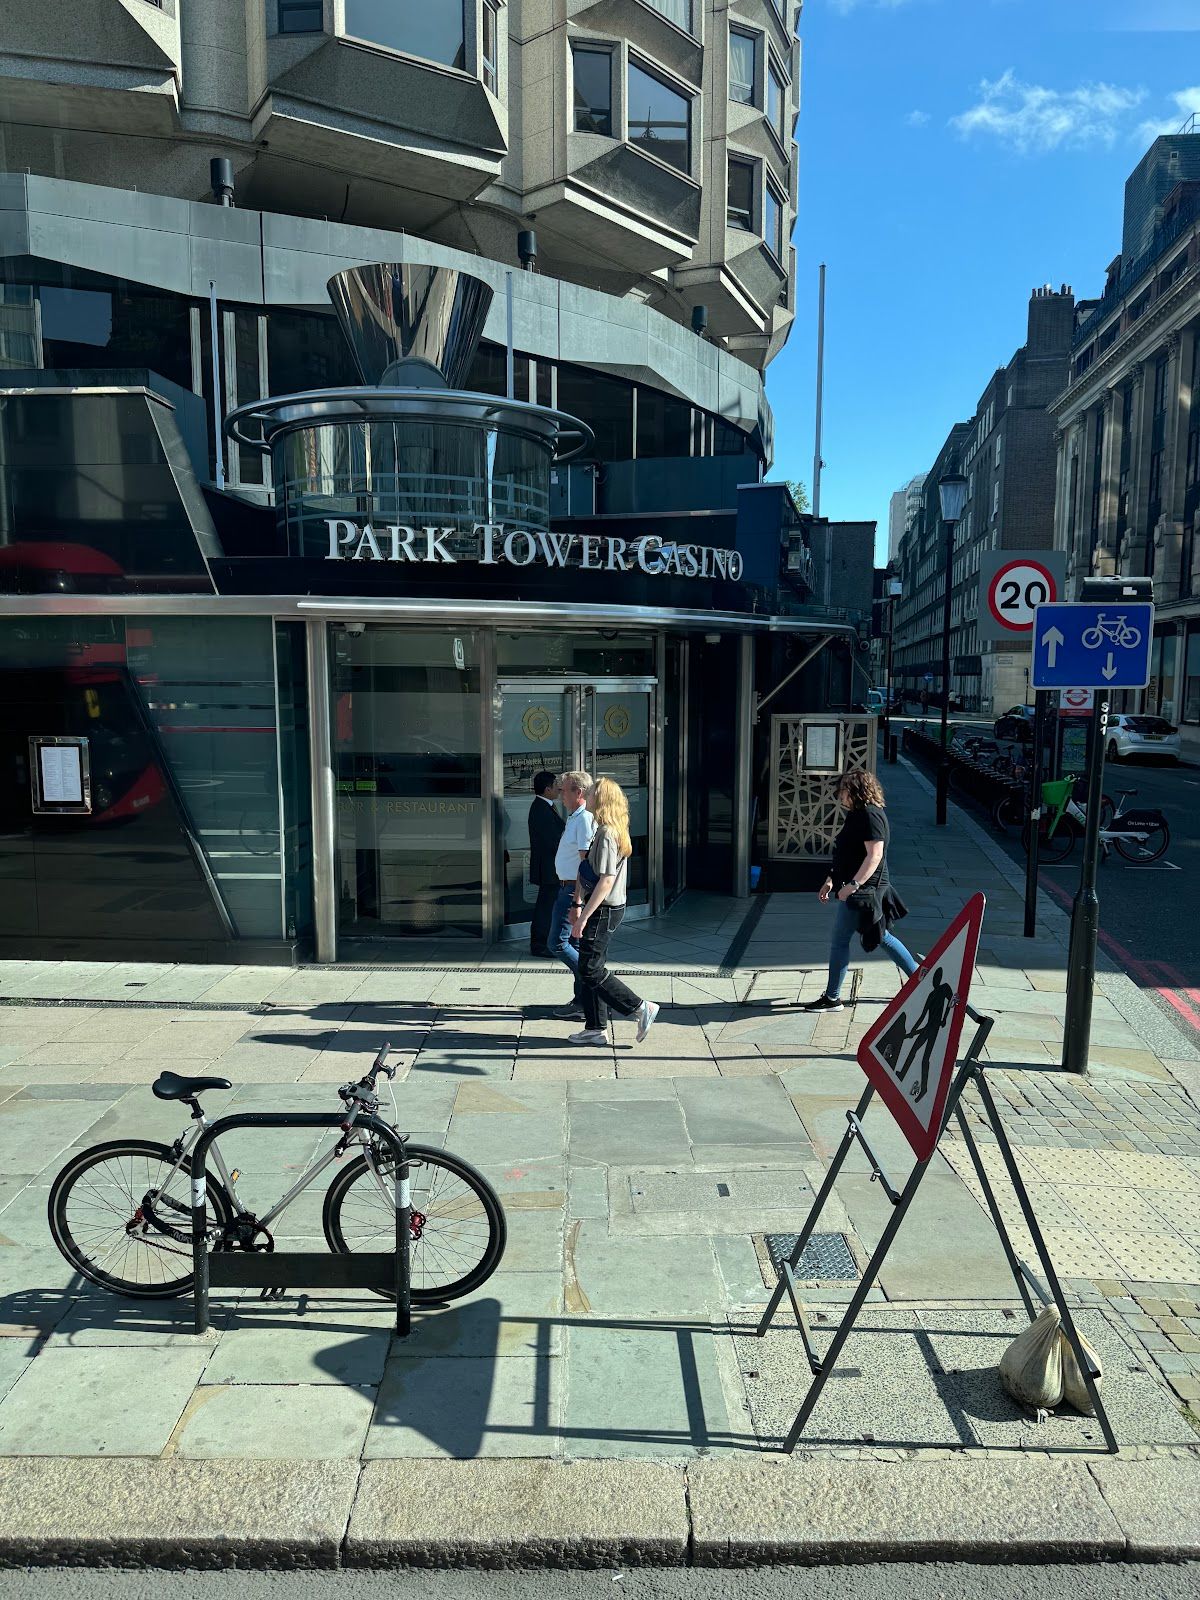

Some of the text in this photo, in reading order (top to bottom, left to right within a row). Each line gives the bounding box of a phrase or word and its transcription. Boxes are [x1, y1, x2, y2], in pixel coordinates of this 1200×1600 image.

[324, 519, 743, 581] PARK TOWER CASINO
[1000, 581, 1047, 609] 20
[387, 803, 477, 813] RESTAURANT
